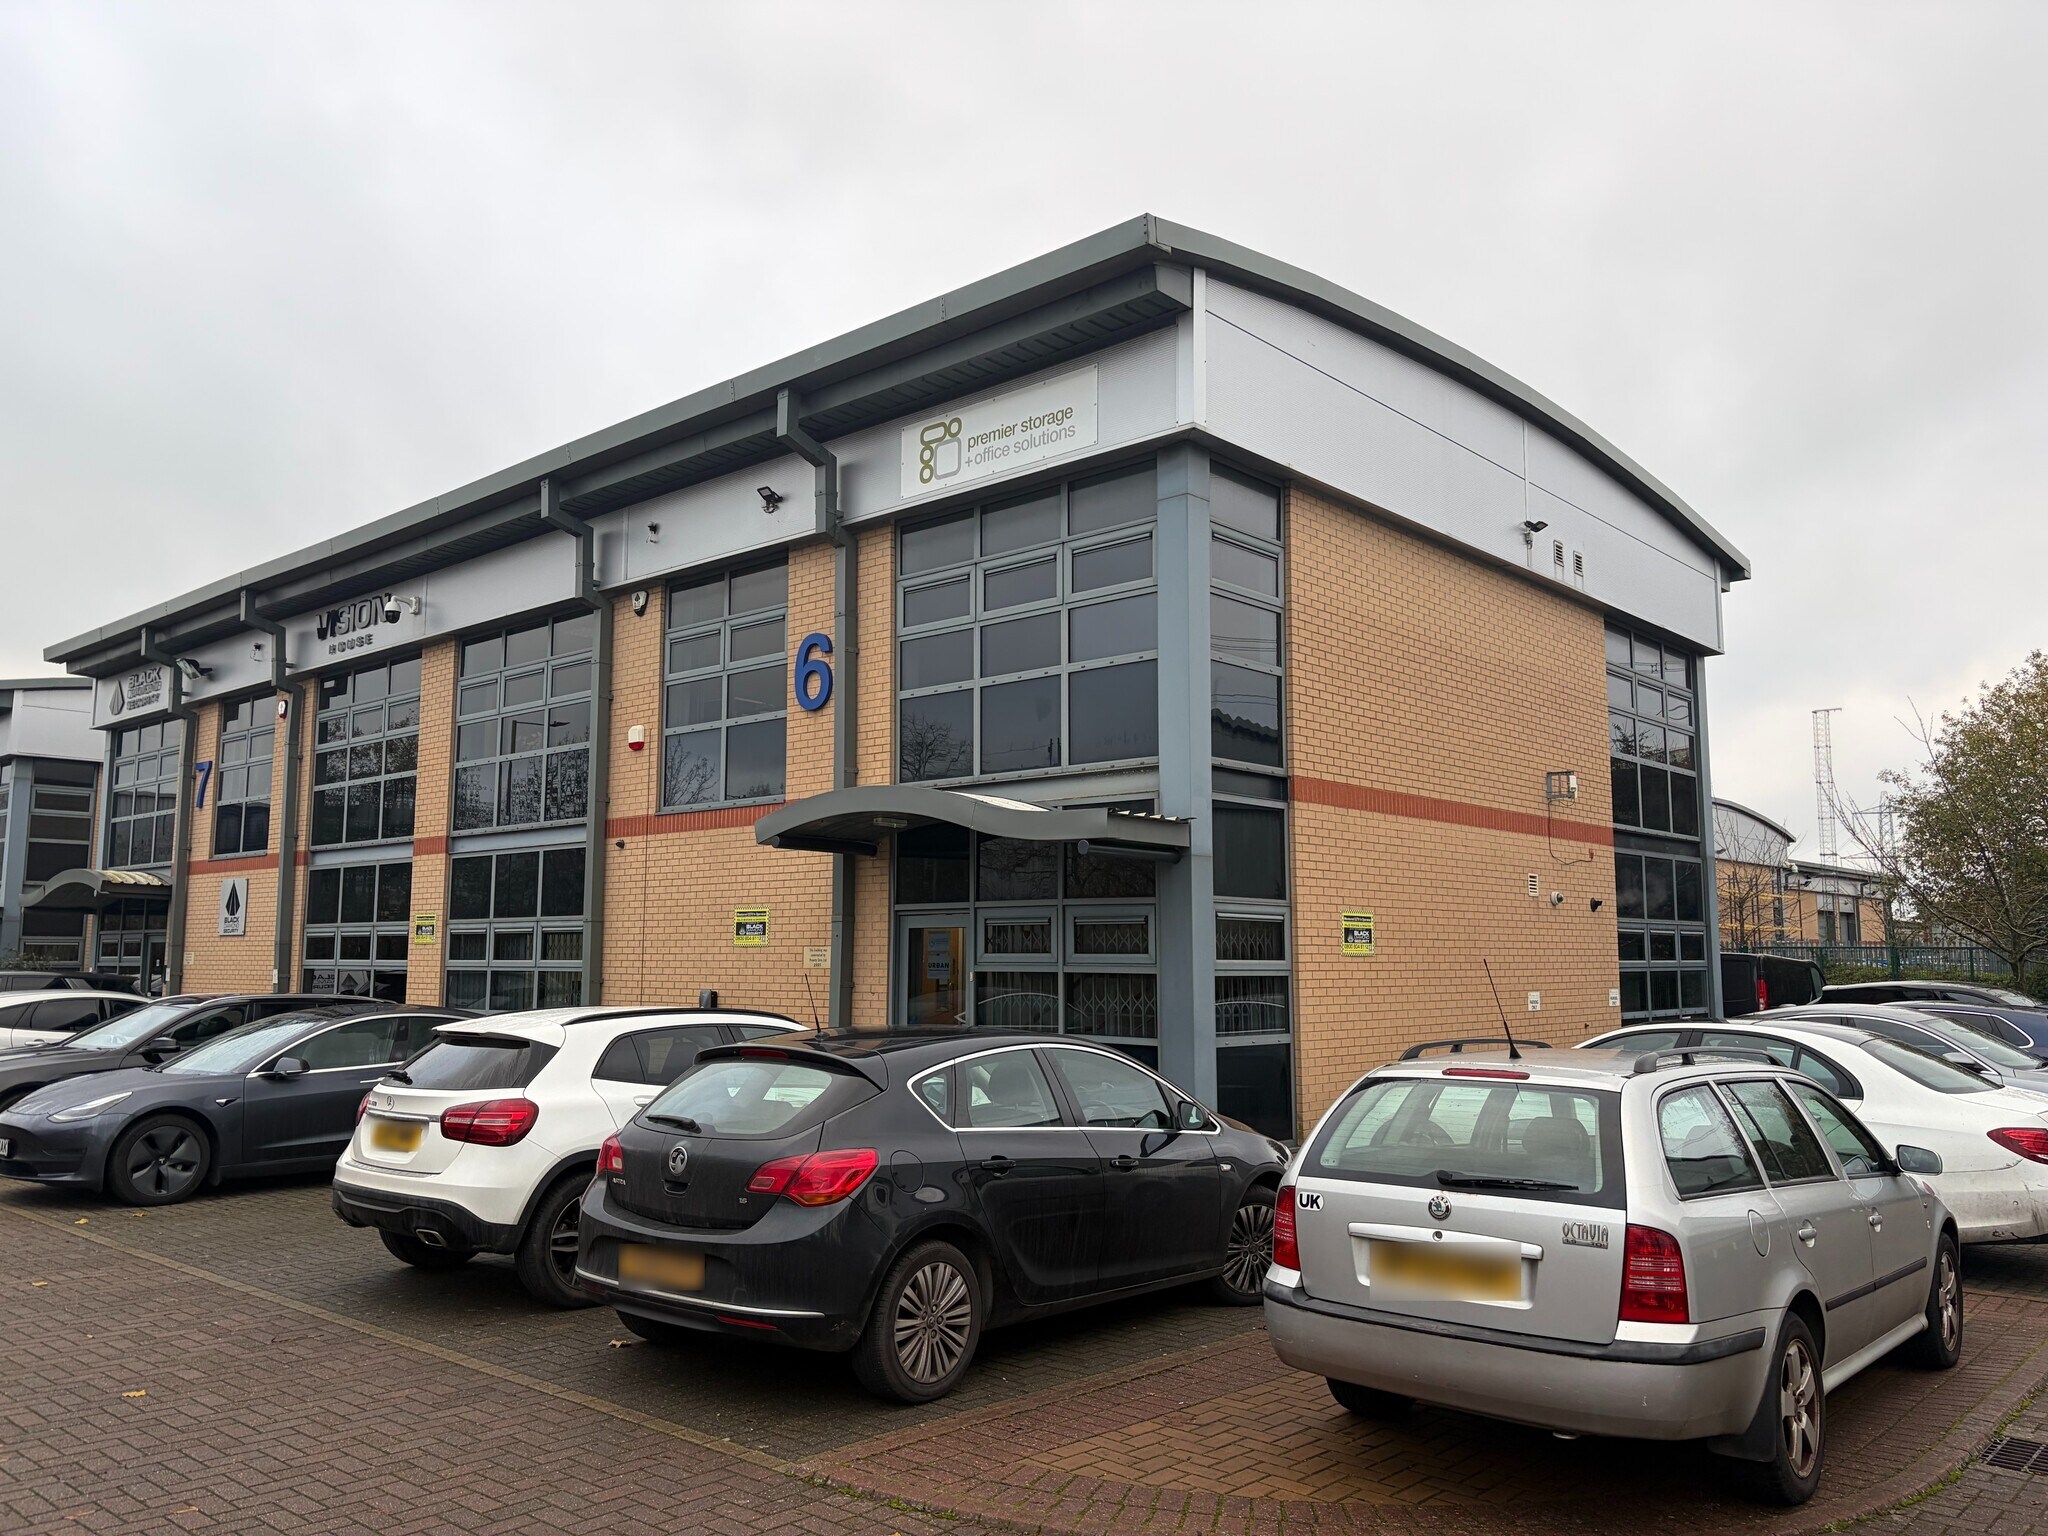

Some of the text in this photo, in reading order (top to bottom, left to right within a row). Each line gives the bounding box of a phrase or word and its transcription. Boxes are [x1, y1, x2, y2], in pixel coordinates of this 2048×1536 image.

[968, 406, 1073, 452] premier storage
[1013, 424, 1076, 454] solutions
[329, 633, 373, 655] HOUSE
[128, 667, 162, 688] BLACK
[795, 633, 833, 711] 6
[195, 761, 213, 808] 7
[1299, 1193, 1320, 1209] UK
[1562, 1220, 1608, 1242] OCTAVIA
